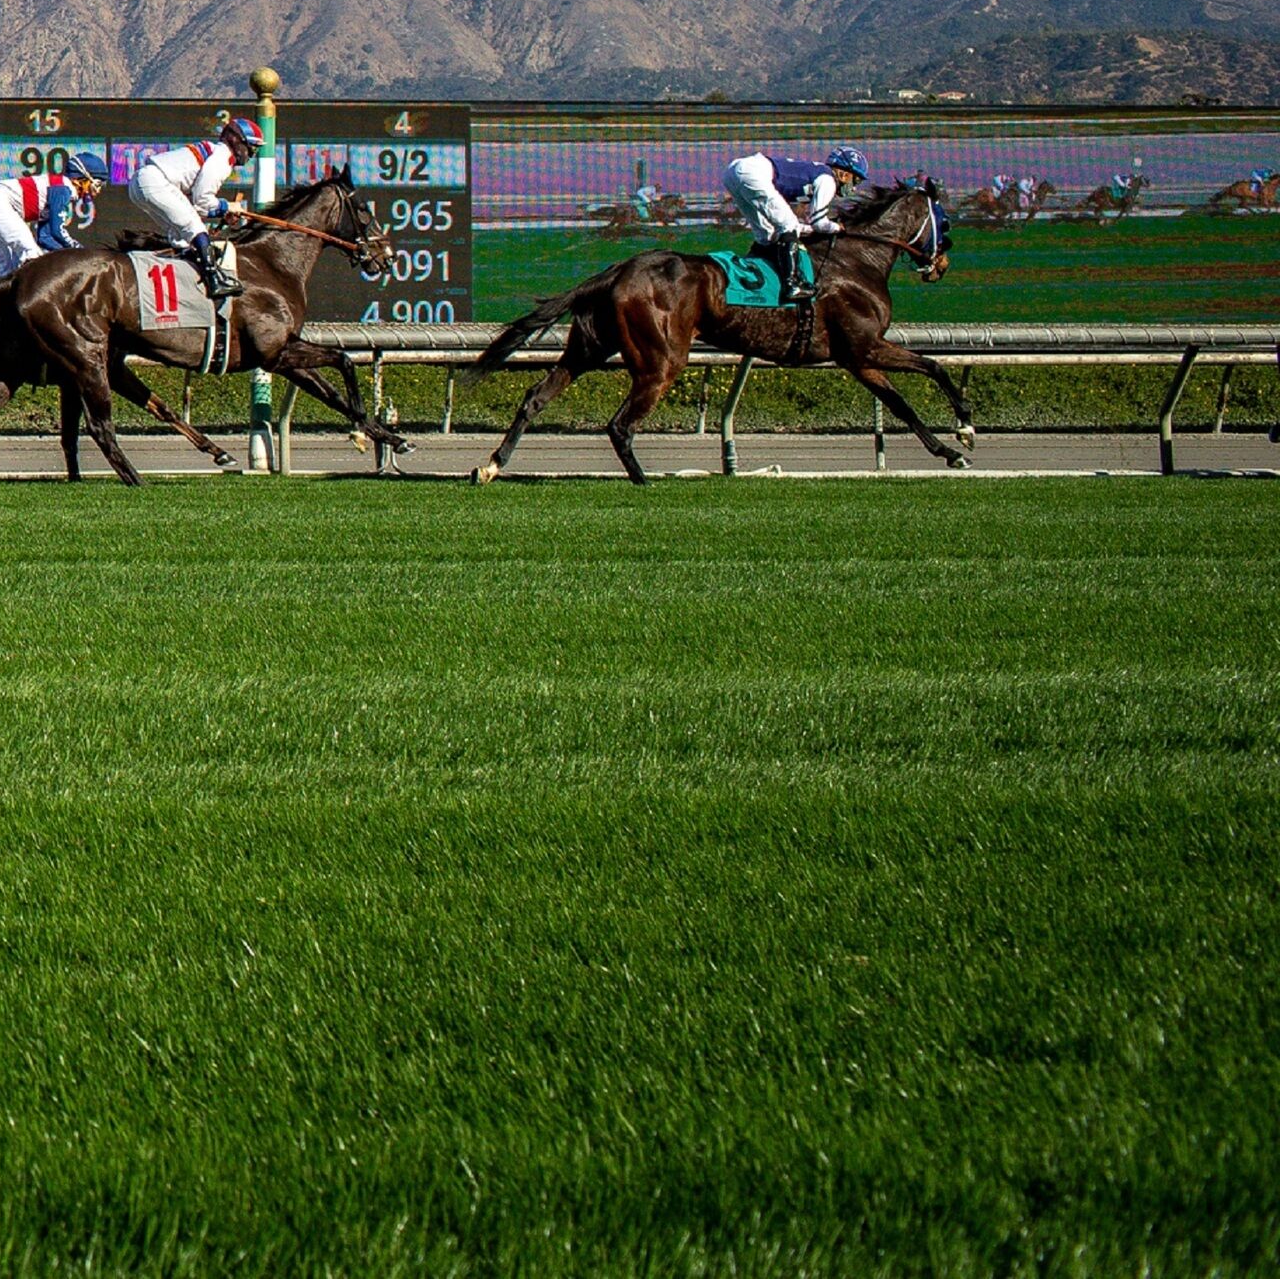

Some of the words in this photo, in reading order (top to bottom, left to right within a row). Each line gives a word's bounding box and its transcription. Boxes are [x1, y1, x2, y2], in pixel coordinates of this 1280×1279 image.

[29, 108, 61, 133] 15
[394, 111, 412, 134] 4
[21, 147, 70, 177] 90
[306, 149, 331, 180] 11
[378, 149, 430, 182] 9/2
[148, 264, 179, 313] 11
[360, 300, 455, 325] 4900
